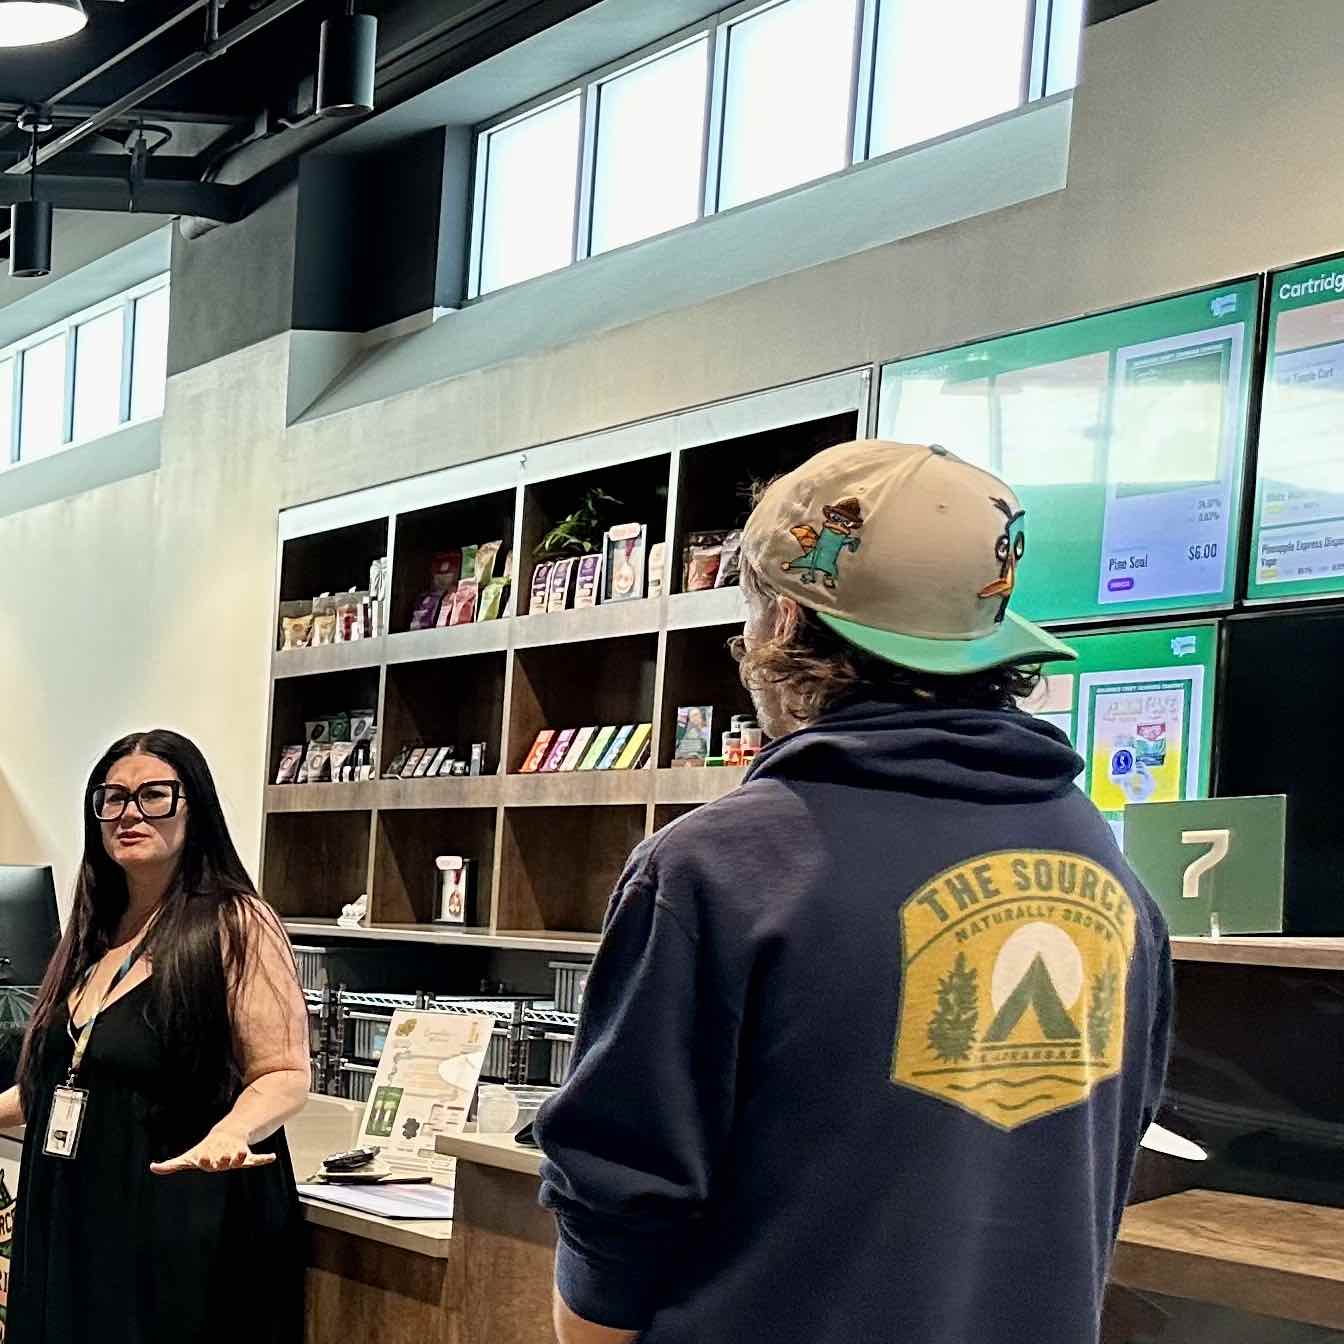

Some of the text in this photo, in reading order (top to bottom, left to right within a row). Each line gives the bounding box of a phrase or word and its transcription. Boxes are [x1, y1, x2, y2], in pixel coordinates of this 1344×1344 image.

[1189, 544, 1217, 561] $6.00
[1182, 829, 1230, 898] 7
[916, 859, 1130, 927] THE SOURCE
[955, 904, 1056, 943] NATURALLY
